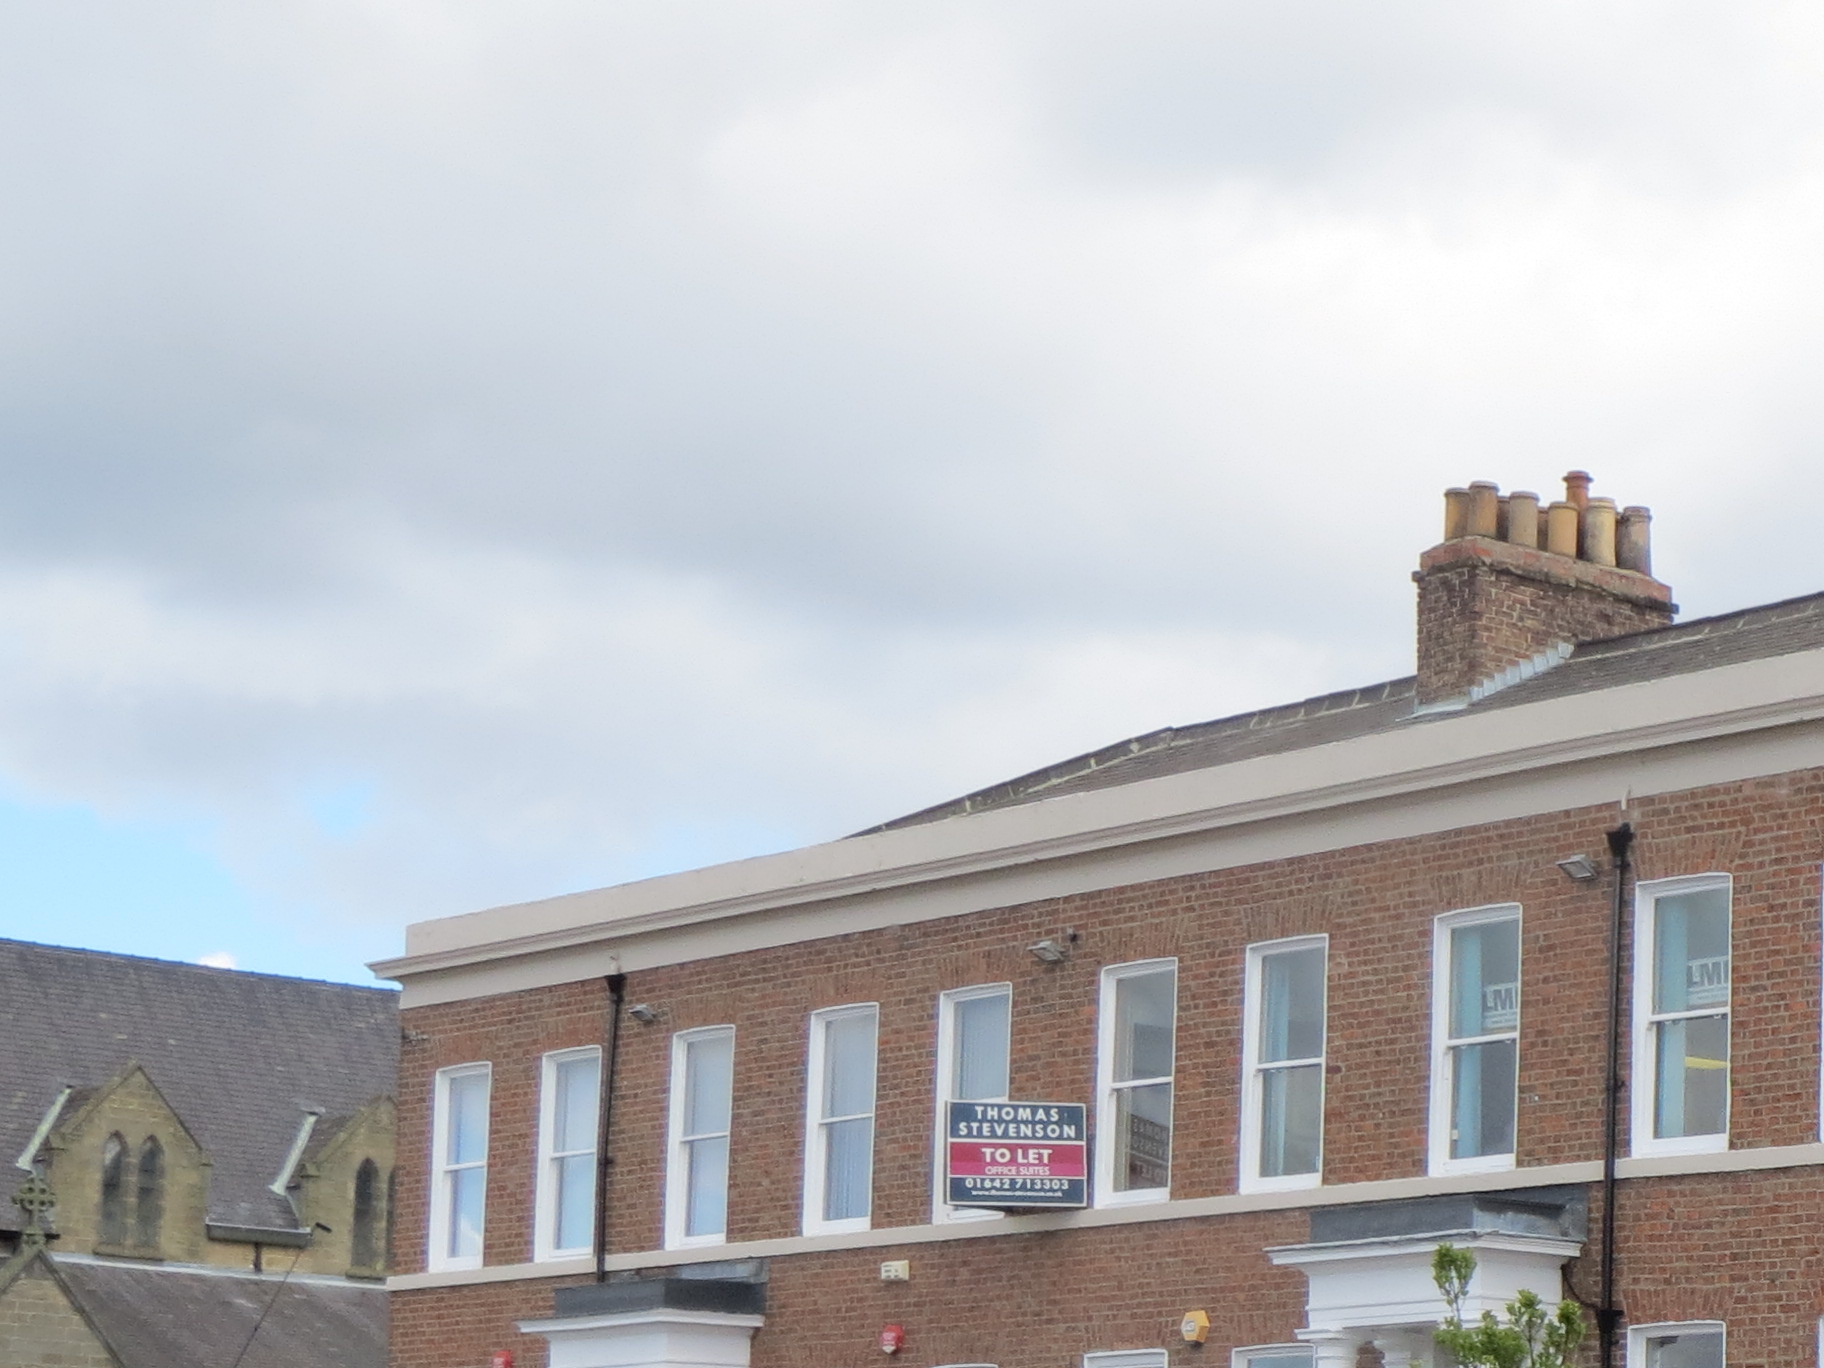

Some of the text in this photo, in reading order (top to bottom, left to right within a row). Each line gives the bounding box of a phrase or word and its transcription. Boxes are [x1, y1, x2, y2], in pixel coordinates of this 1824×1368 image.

[975, 1105, 1059, 1121] THOMAS
[958, 1122, 1076, 1138] STEVENSON
[981, 1148, 1053, 1164] TO LET
[985, 1166, 1050, 1175] OFFICE SUITES
[965, 1178, 1069, 1190] 01642 713303
